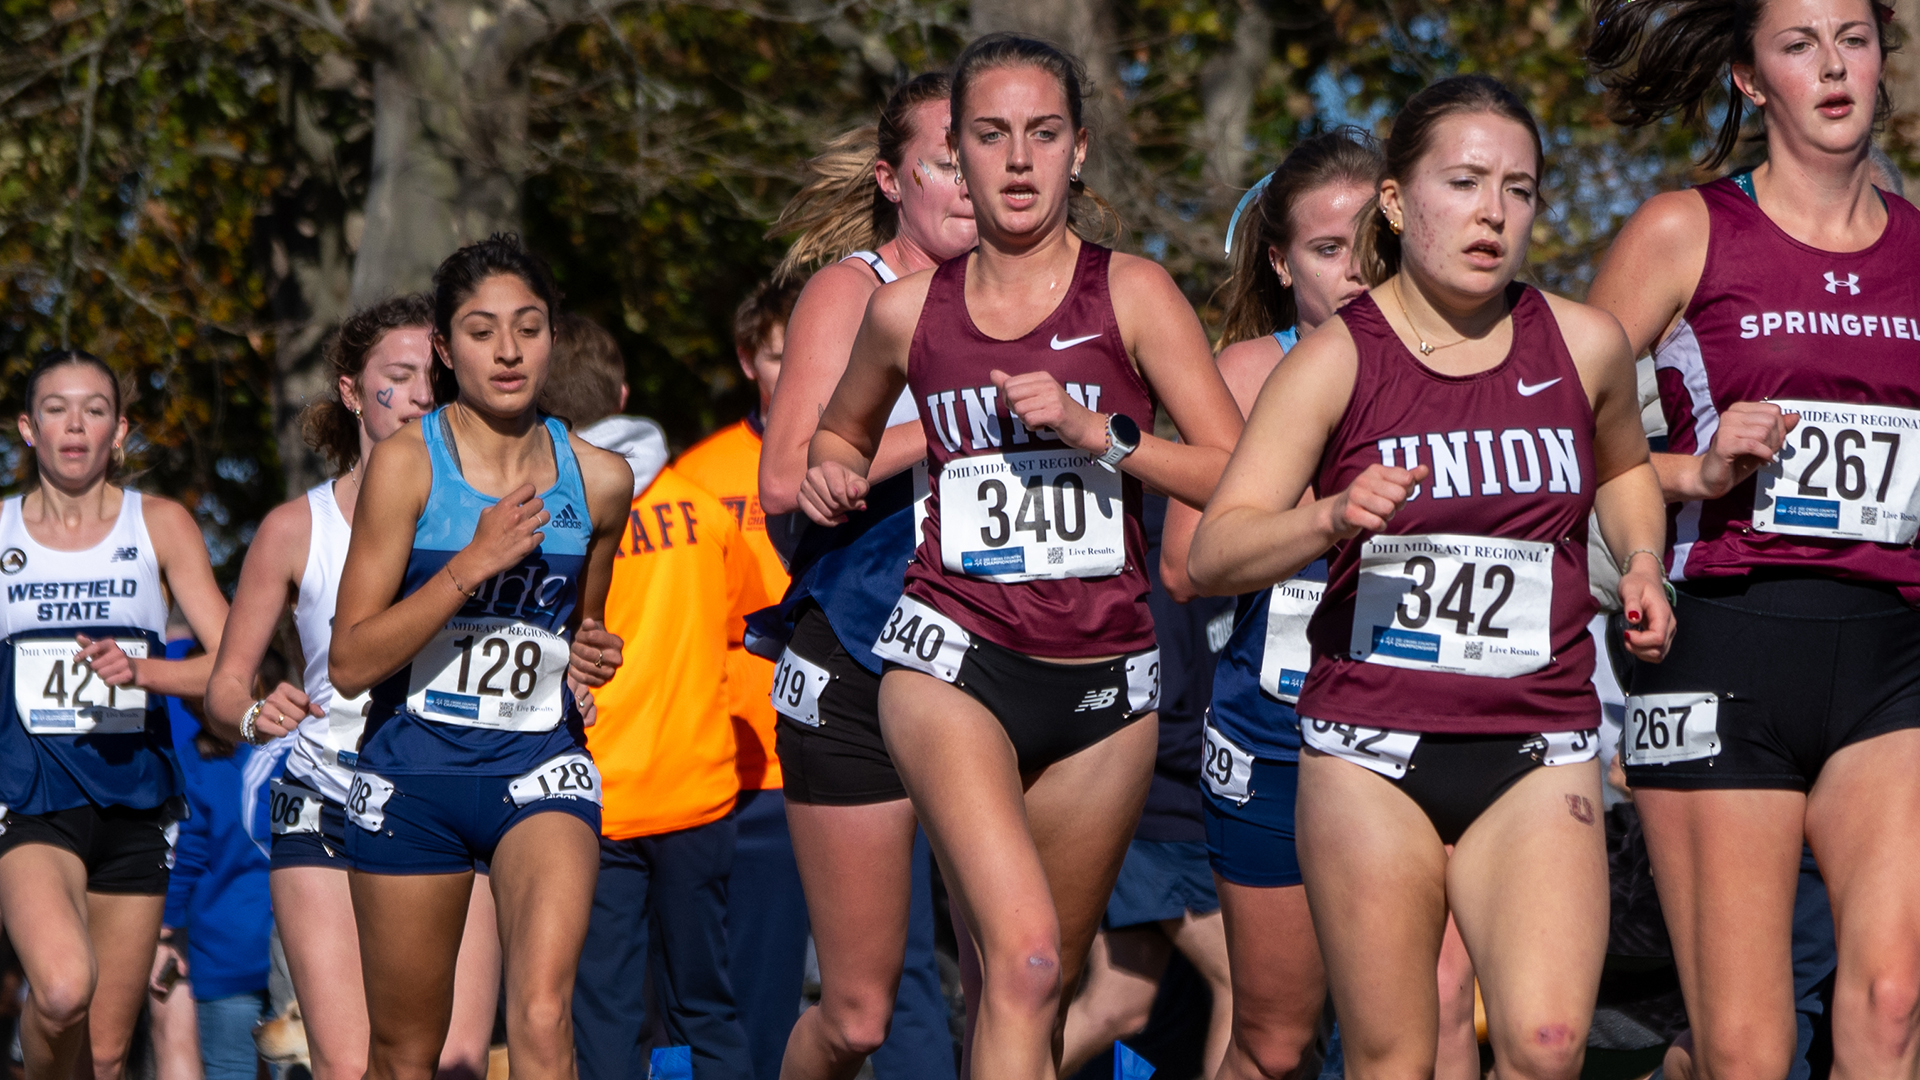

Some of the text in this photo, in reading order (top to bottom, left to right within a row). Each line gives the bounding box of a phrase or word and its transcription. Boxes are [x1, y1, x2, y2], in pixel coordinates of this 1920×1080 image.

[1740, 311, 1920, 341] SPRINGFIEL
[947, 456, 1101, 479] DIII MIDEAST REGIONA
[1378, 428, 1582, 502] UNION
[1798, 426, 1900, 503] 267
[552, 518, 582, 529] adidas
[977, 472, 1086, 548] 340
[614, 500, 697, 558] AFF
[1068, 547, 1116, 556] Live Results
[1372, 543, 1543, 563] DIII MIDEAST REGIONAL
[7, 579, 138, 604] WESTFIELD
[1282, 586, 1304, 599] DIII
[1396, 555, 1515, 639] 342
[37, 601, 111, 622] STATE
[452, 622, 503, 634] MIDEAST
[880, 606, 946, 662] 340
[1489, 645, 1540, 657] Live Results
[453, 634, 542, 700] 128
[517, 703, 529, 711] Live
[1633, 705, 1692, 750] 267
[1204, 733, 1233, 785] 29
[270, 789, 304, 827] 06
